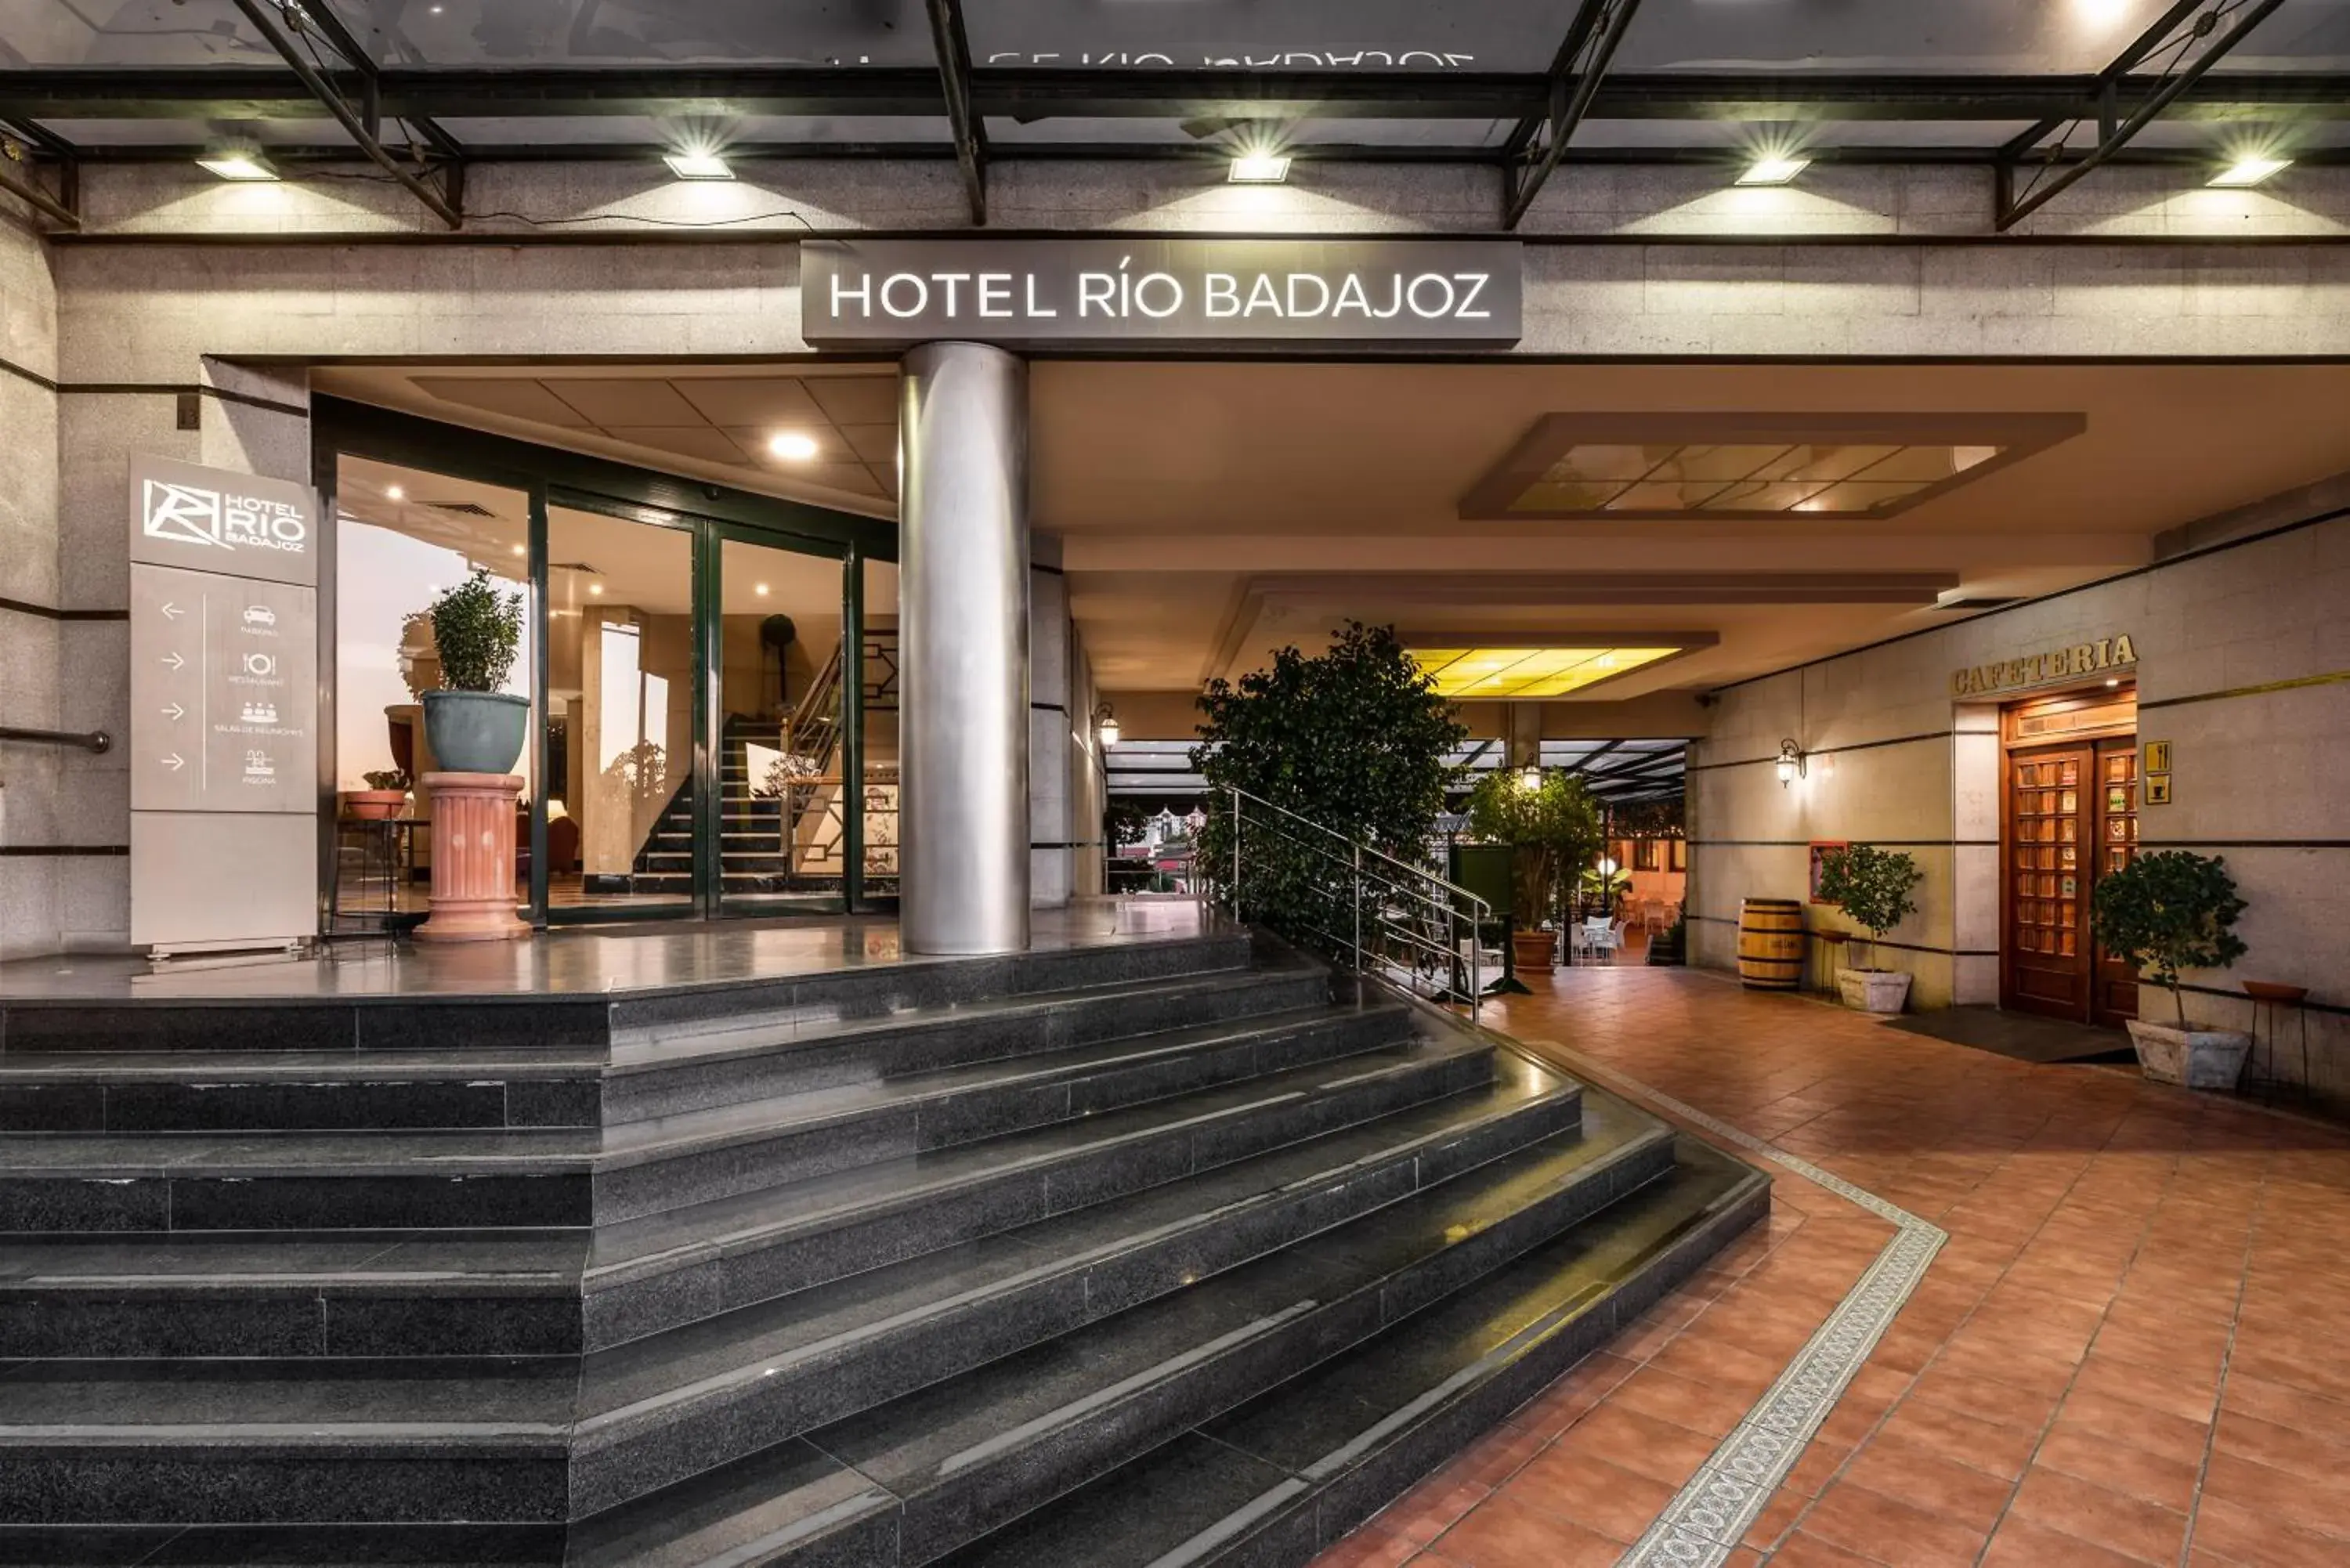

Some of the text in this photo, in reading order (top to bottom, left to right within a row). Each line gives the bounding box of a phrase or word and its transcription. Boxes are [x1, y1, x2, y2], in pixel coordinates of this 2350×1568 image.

[830, 255, 1491, 318] HOTEL RÍO BADAJOZ
[224, 493, 304, 519] HOTEL
[224, 508, 306, 542] RIO
[225, 532, 305, 553] BADAJOZ
[1951, 632, 2138, 695] CAFETERIA
